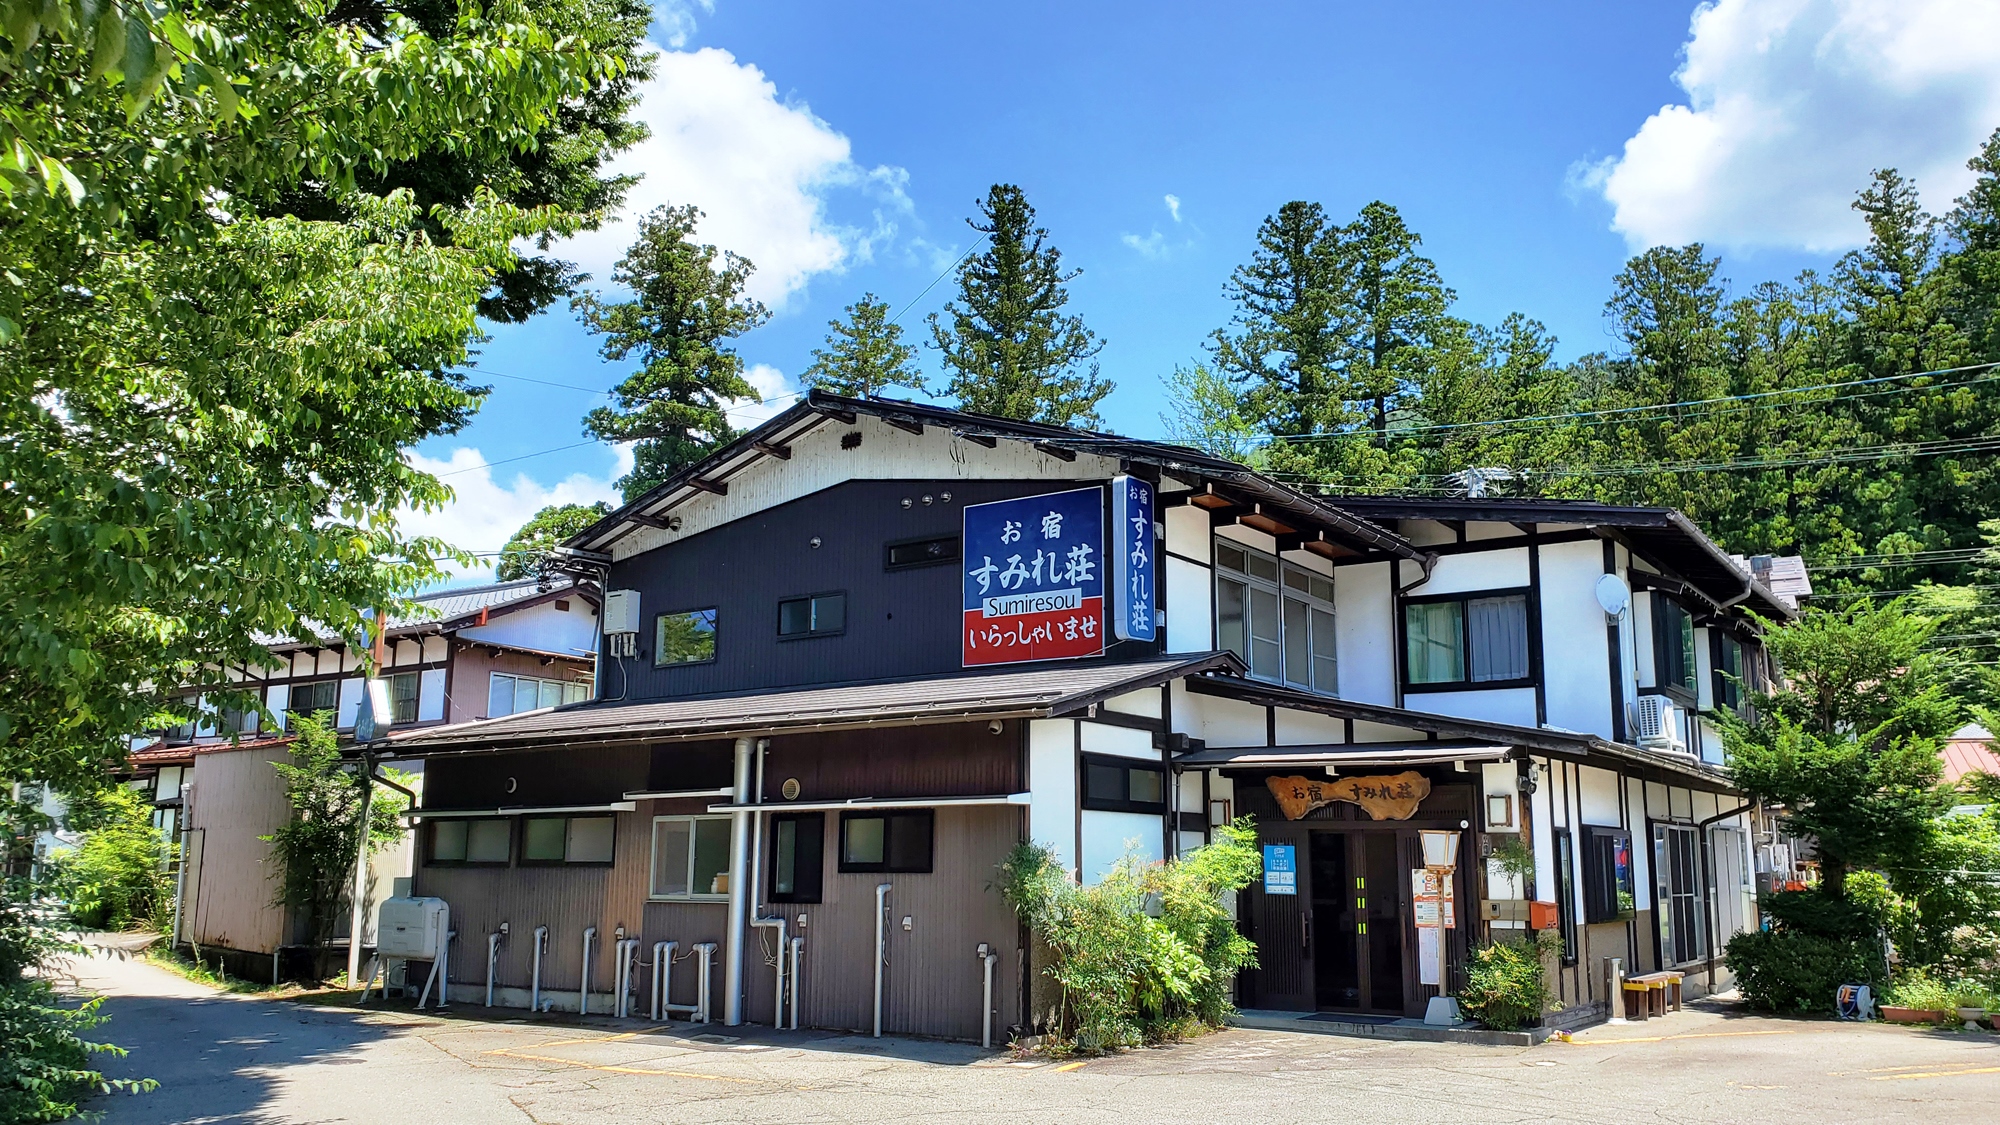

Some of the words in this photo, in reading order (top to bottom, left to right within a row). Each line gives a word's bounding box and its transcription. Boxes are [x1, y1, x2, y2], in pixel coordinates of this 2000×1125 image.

[1129, 485, 1148, 505] お宿
[1001, 511, 1063, 544] お宿
[969, 543, 1096, 595] すみれ荘
[1131, 508, 1149, 631] すみれ荘
[988, 594, 1075, 616] Sumiresou
[970, 615, 1097, 648] いらっしゃいませ
[1292, 785, 1322, 802] お宿
[1349, 782, 1415, 800] すみれ荘
